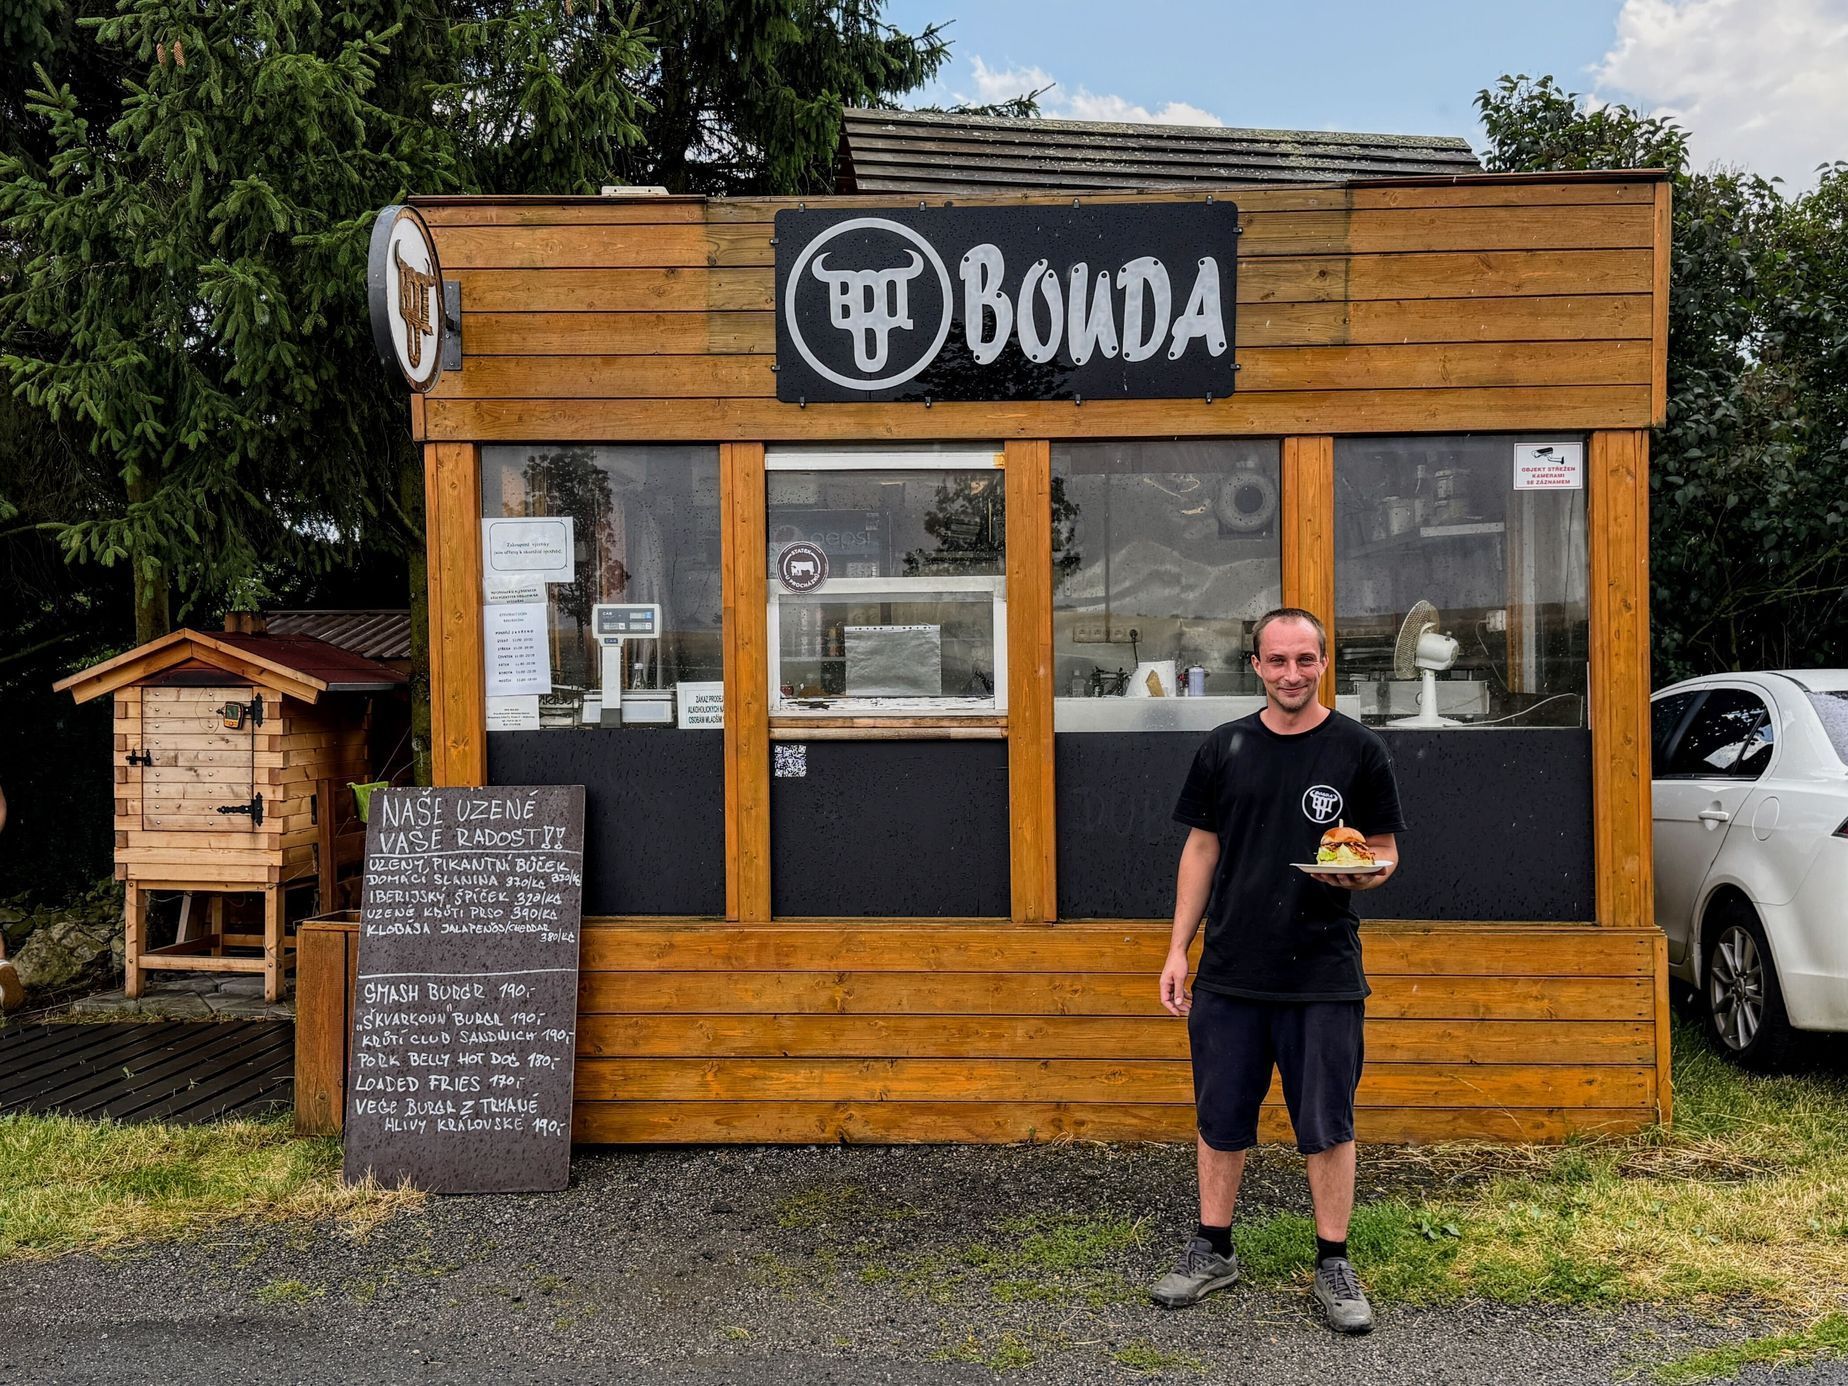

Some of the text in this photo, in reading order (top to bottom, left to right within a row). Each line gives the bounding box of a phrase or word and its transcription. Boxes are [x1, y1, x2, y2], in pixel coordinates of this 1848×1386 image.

[959, 243, 1227, 366] BOUDA
[790, 547, 812, 556] STATEK
[382, 789, 539, 827] NAŠE UZENÉ
[380, 825, 443, 854] VAŠE
[431, 854, 513, 873] PIKANTNÍ
[433, 873, 499, 886] SLANINA
[369, 887, 446, 908] IBERIJSKÝ
[454, 887, 510, 905] ŠPÍČEK
[366, 904, 415, 919] UZENÉ
[469, 906, 504, 919] PRSO
[366, 919, 431, 937] KLOBÁSA
[364, 982, 419, 1004] SMASH
[427, 982, 486, 1001] BURGR
[451, 1012, 504, 1026] BURGR
[410, 1031, 451, 1045] CLUB
[459, 1029, 538, 1046] SANDWICH
[357, 1052, 401, 1068] PORK
[407, 1052, 451, 1067] BELLY
[457, 1052, 486, 1065] HOT
[490, 1052, 521, 1068] DOG
[355, 1074, 420, 1092] LOADED
[428, 1074, 481, 1092] FRIES
[404, 1097, 457, 1117] BURGR
[479, 1092, 540, 1114] TRHANÉ
[384, 1116, 427, 1135] HLIVY
[437, 1114, 524, 1132] KRÁLOVSKÉ
